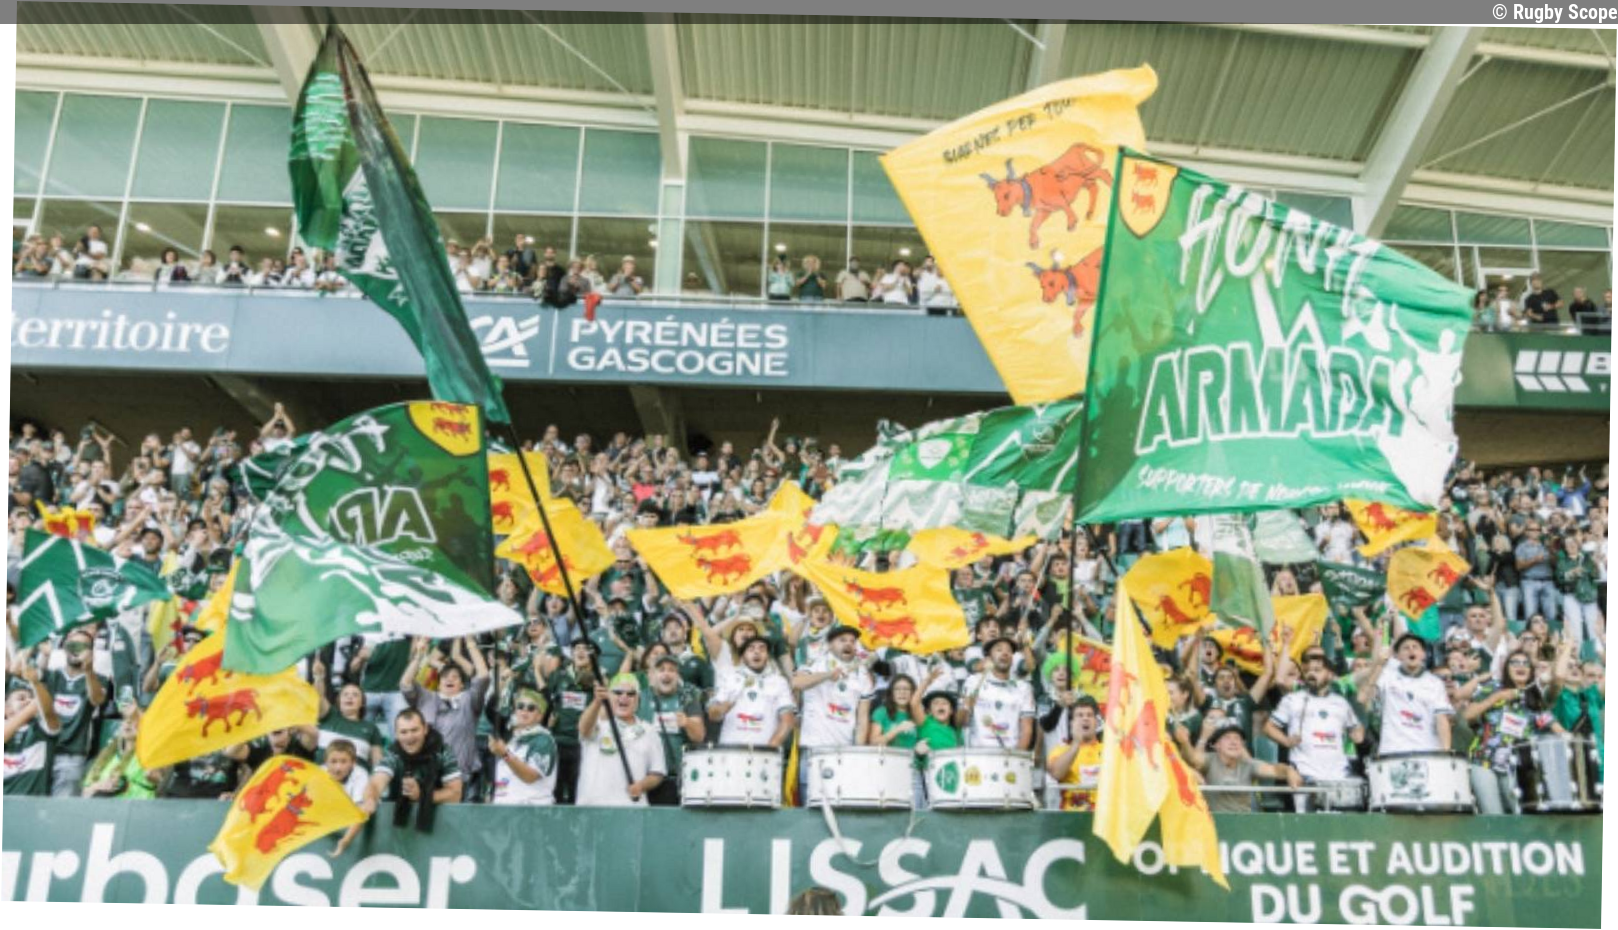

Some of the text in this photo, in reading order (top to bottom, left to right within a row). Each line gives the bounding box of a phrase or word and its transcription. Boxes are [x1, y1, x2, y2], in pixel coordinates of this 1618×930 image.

[570, 314, 789, 348] PYRÉNÉES
[567, 346, 789, 377] GASCOGNE
[1135, 342, 1404, 455] ARMADA
[1133, 840, 1585, 876] OIQUE ET AUDITION
[701, 838, 1089, 920] LISSAC
[1250, 883, 1323, 925] DU
[1338, 884, 1476, 926] GOLF
